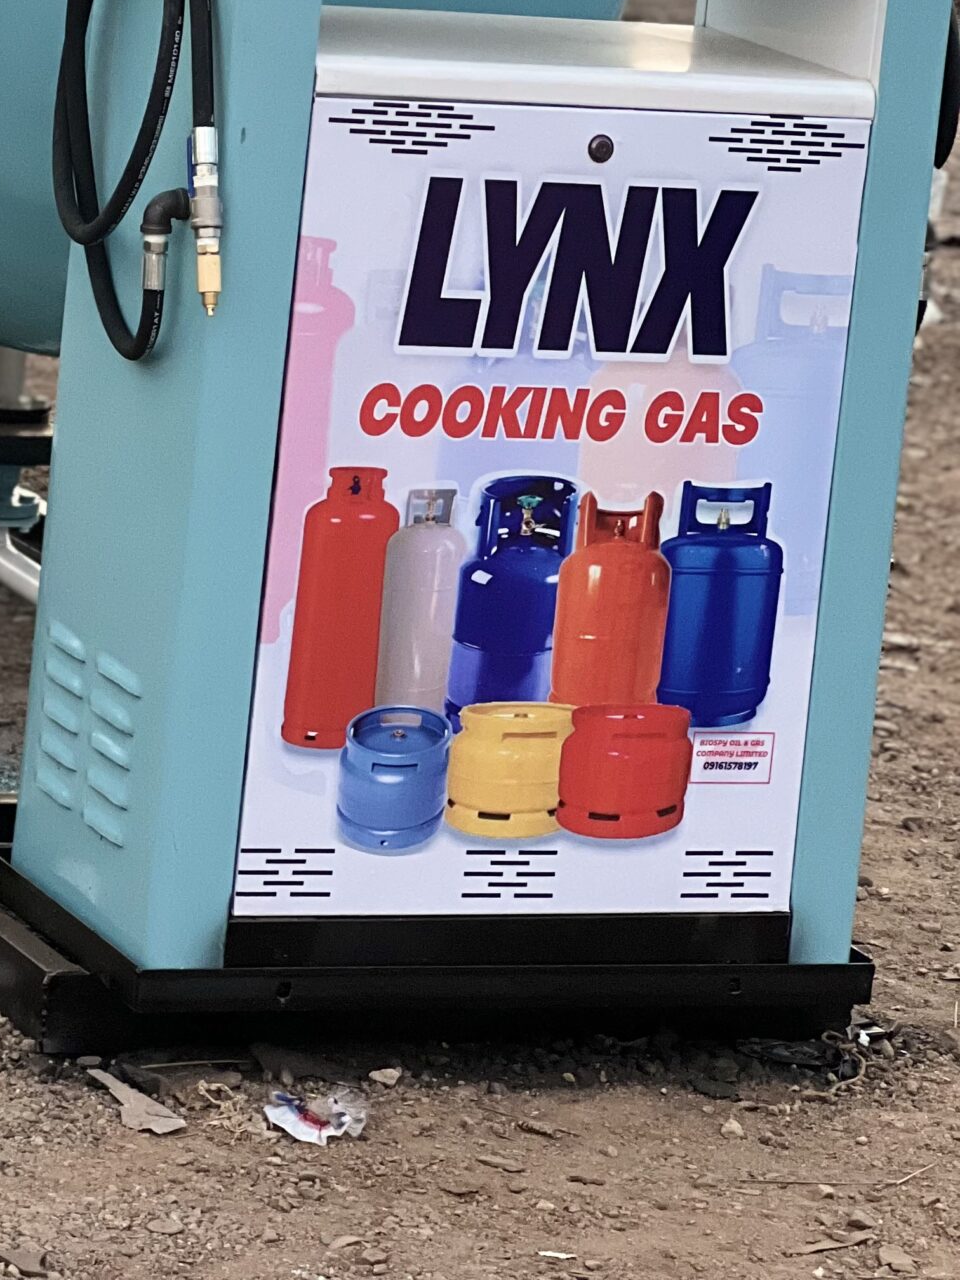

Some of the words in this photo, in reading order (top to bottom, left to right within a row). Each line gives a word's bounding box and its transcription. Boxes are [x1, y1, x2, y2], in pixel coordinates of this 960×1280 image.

[398, 176, 760, 357] LYNX
[359, 382, 626, 443] COOKING
[644, 390, 763, 446] GAS
[700, 739, 728, 747] BIOSPY
[729, 739, 742, 747] OIL
[696, 750, 735, 758] COMPANY
[703, 761, 759, 771] 09161578197
